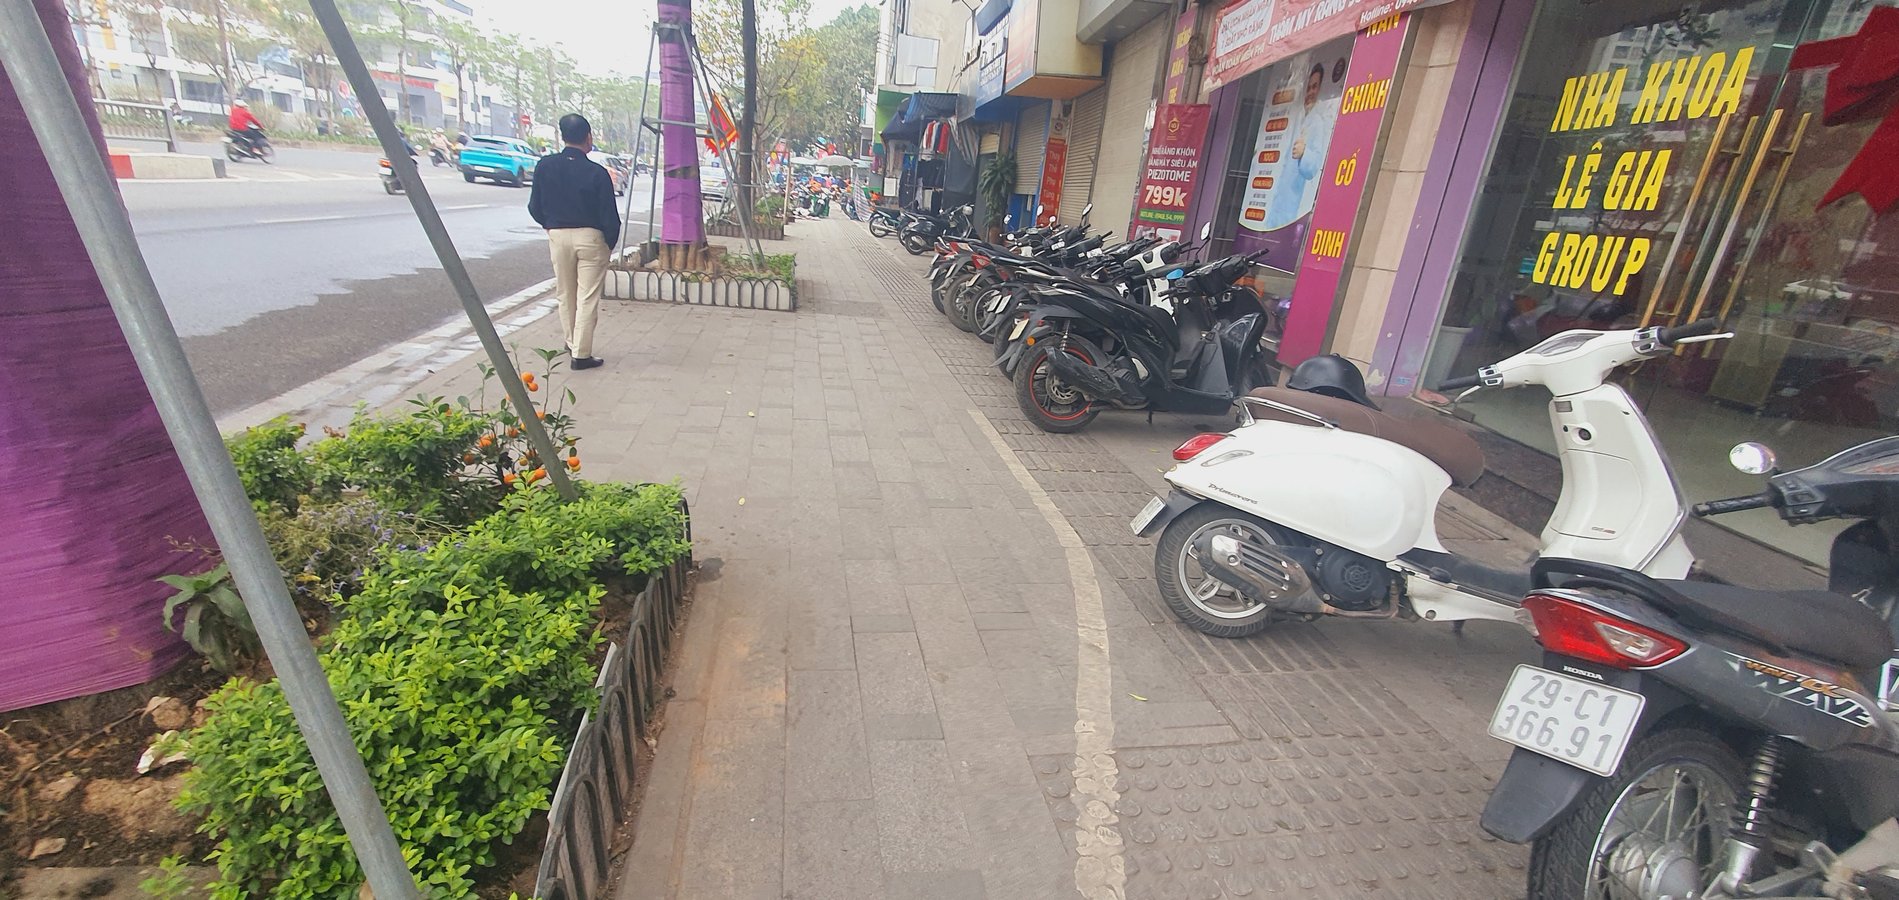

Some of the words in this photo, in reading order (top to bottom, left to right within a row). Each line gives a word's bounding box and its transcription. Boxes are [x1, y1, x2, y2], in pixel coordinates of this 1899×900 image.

[1360, 3, 1394, 26] Hotline:
[1341, 73, 1391, 115] CHỈNH
[1551, 68, 1628, 133] NHA
[1631, 46, 1755, 125] KHOA
[1147, 169, 1192, 182] PIEZOTOME
[1335, 148, 1361, 187] CỐ
[1552, 141, 1604, 209] LÊ
[1603, 149, 1672, 211] GIA
[1144, 184, 1187, 207] 799k
[1311, 229, 1346, 262] ĐỊNH
[1532, 232, 1651, 296] GROUP
[1563, 665, 1604, 681] HONDA
[1520, 674, 1618, 727] 29-C1
[1498, 704, 1613, 767] 366.91
